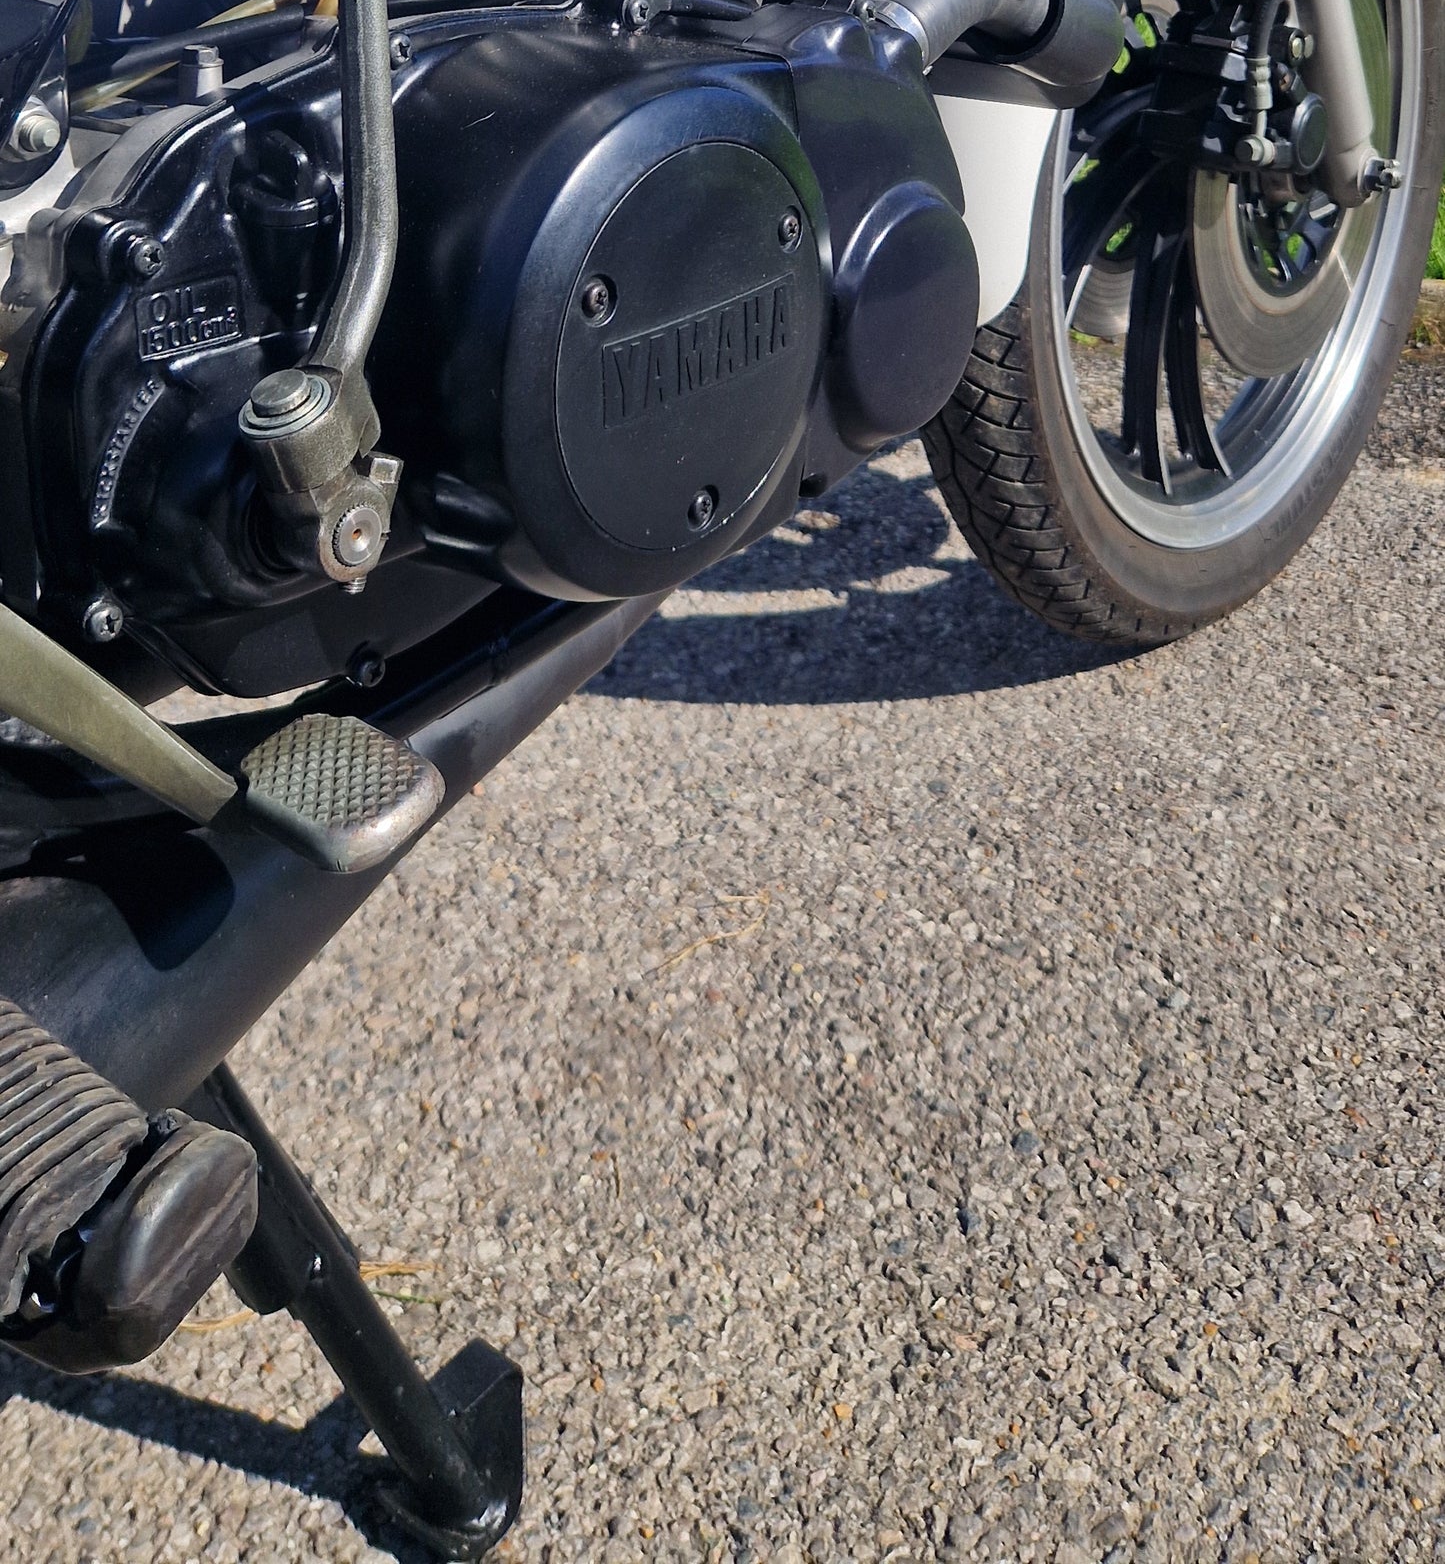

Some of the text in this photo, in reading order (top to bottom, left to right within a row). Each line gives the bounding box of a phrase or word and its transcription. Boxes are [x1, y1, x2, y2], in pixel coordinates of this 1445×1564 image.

[150, 287, 206, 322] OIL
[612, 283, 787, 417] YAMAHA
[93, 379, 160, 520] KICKSTARTER
